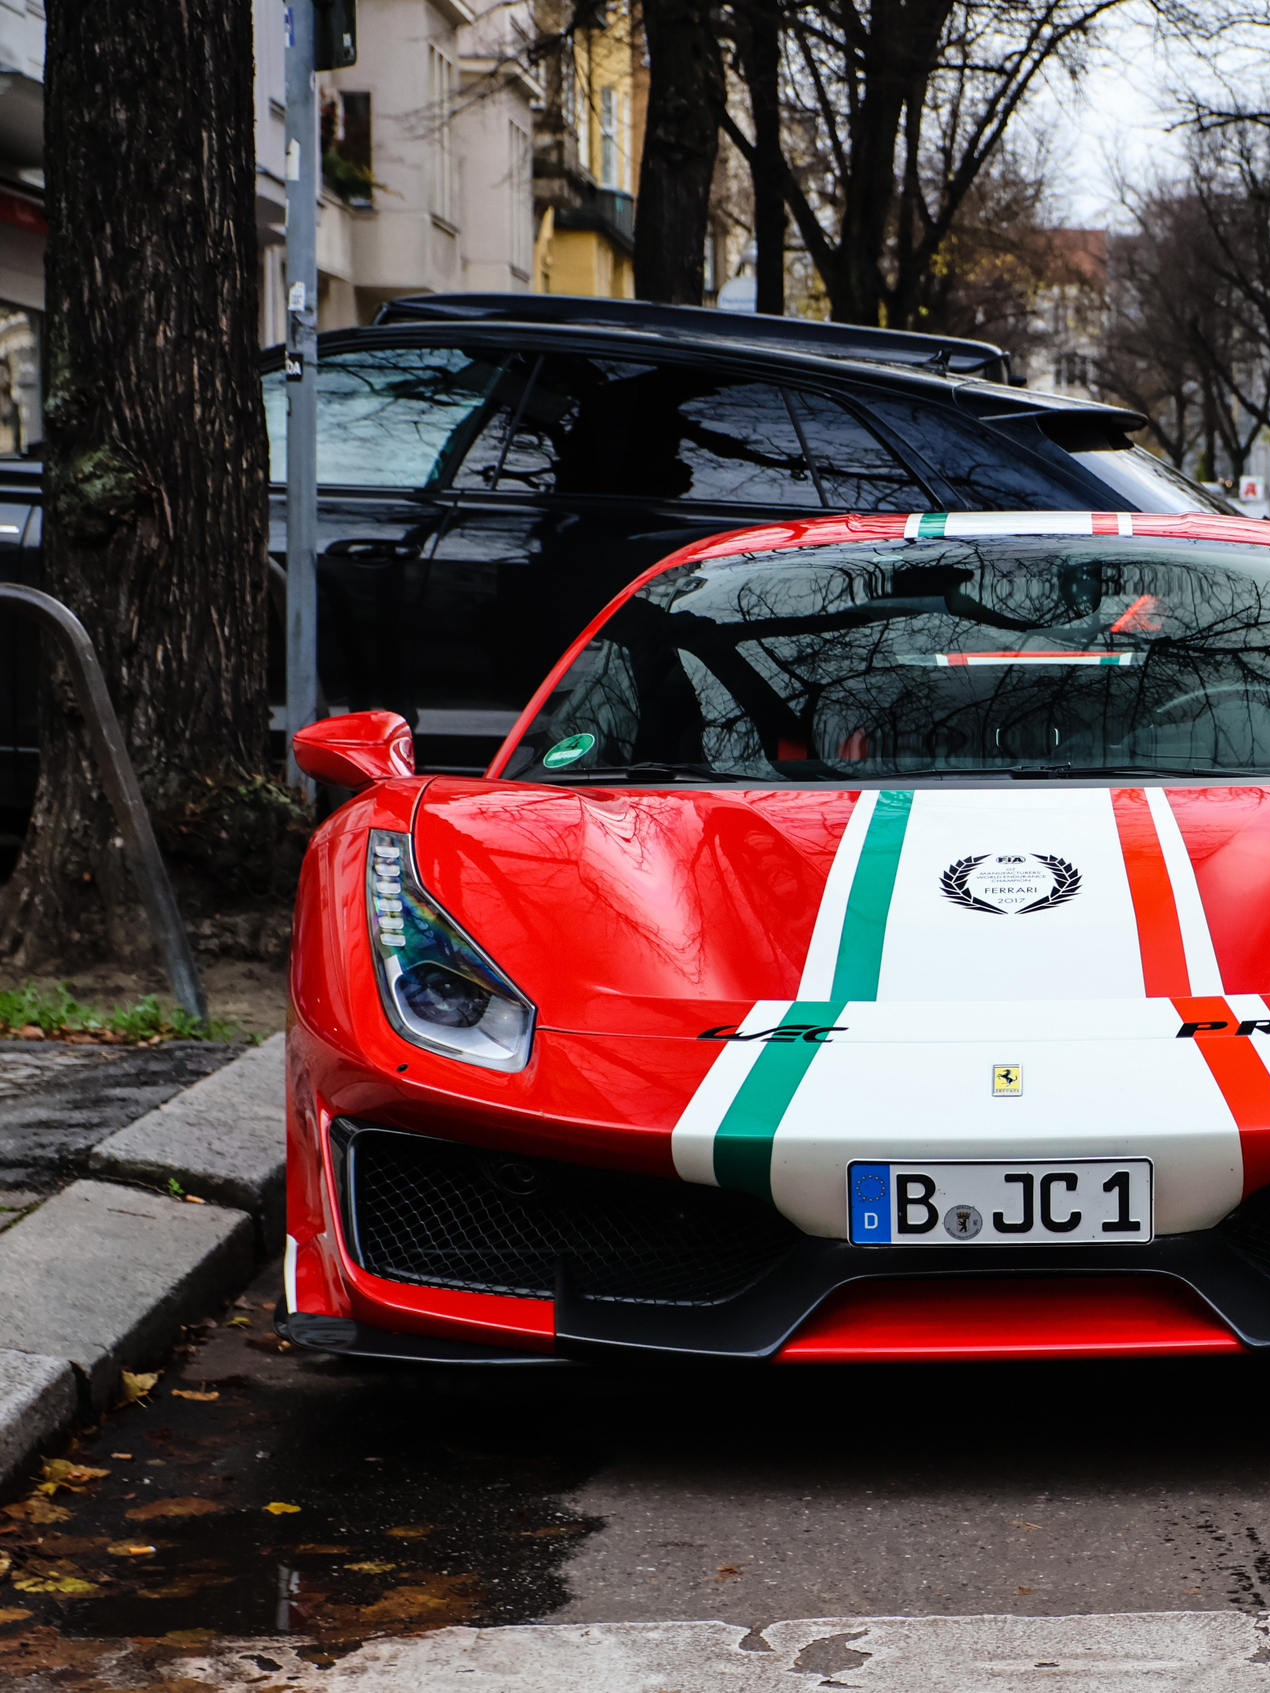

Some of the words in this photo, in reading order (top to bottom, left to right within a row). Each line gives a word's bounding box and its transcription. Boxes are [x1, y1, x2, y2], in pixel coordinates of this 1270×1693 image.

[696, 1024, 849, 1043] WEC
[896, 1173, 939, 1234] B
[993, 1171, 1082, 1233] JC
[1101, 1171, 1141, 1232] 1
[864, 1212, 878, 1229] D
